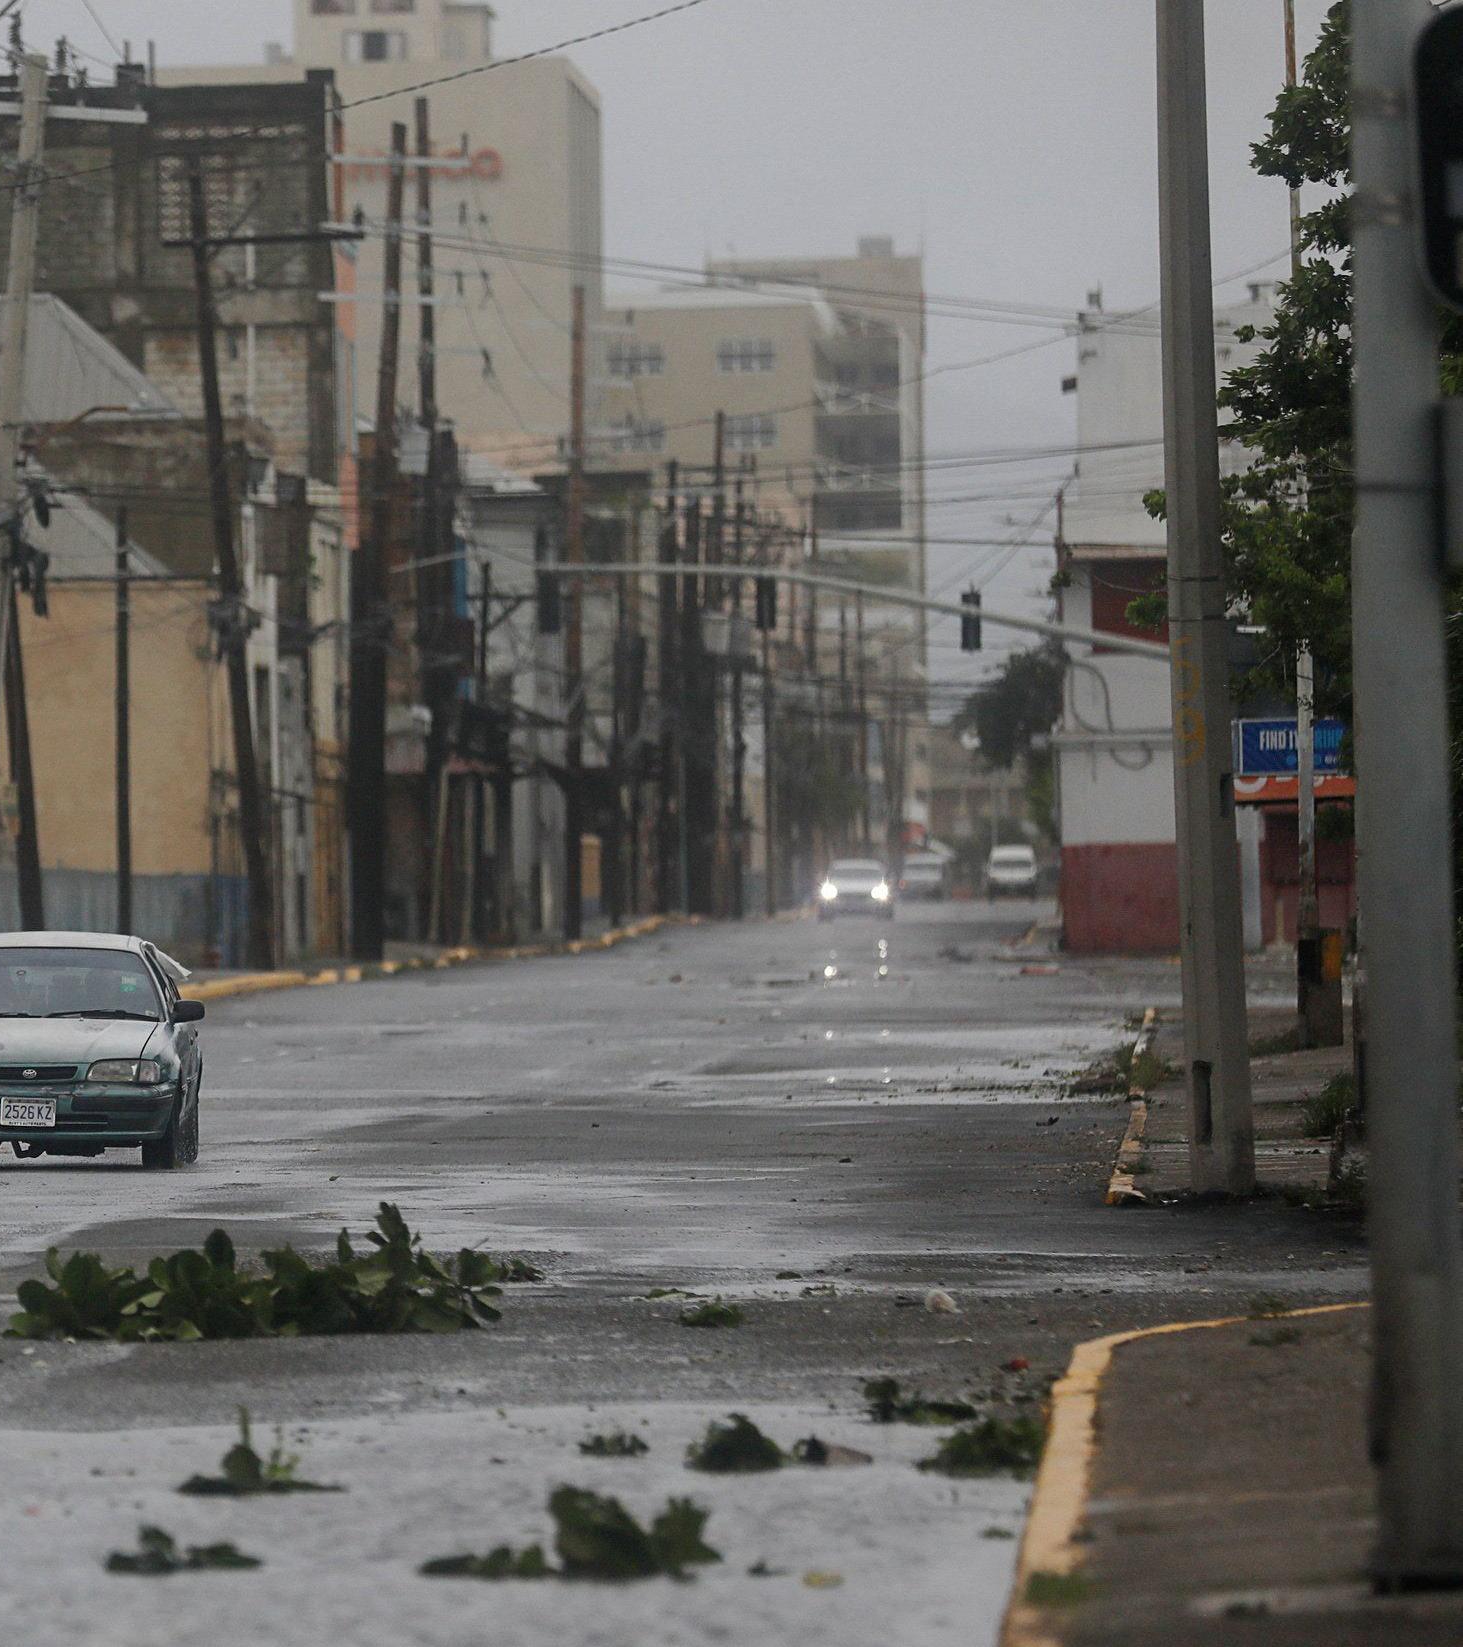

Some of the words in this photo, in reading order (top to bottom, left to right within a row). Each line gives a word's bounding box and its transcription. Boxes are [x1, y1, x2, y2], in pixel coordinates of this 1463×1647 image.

[1259, 730, 1286, 751] FIND
[5, 1105, 34, 1119] 2526
[37, 1106, 52, 1120] KZ
